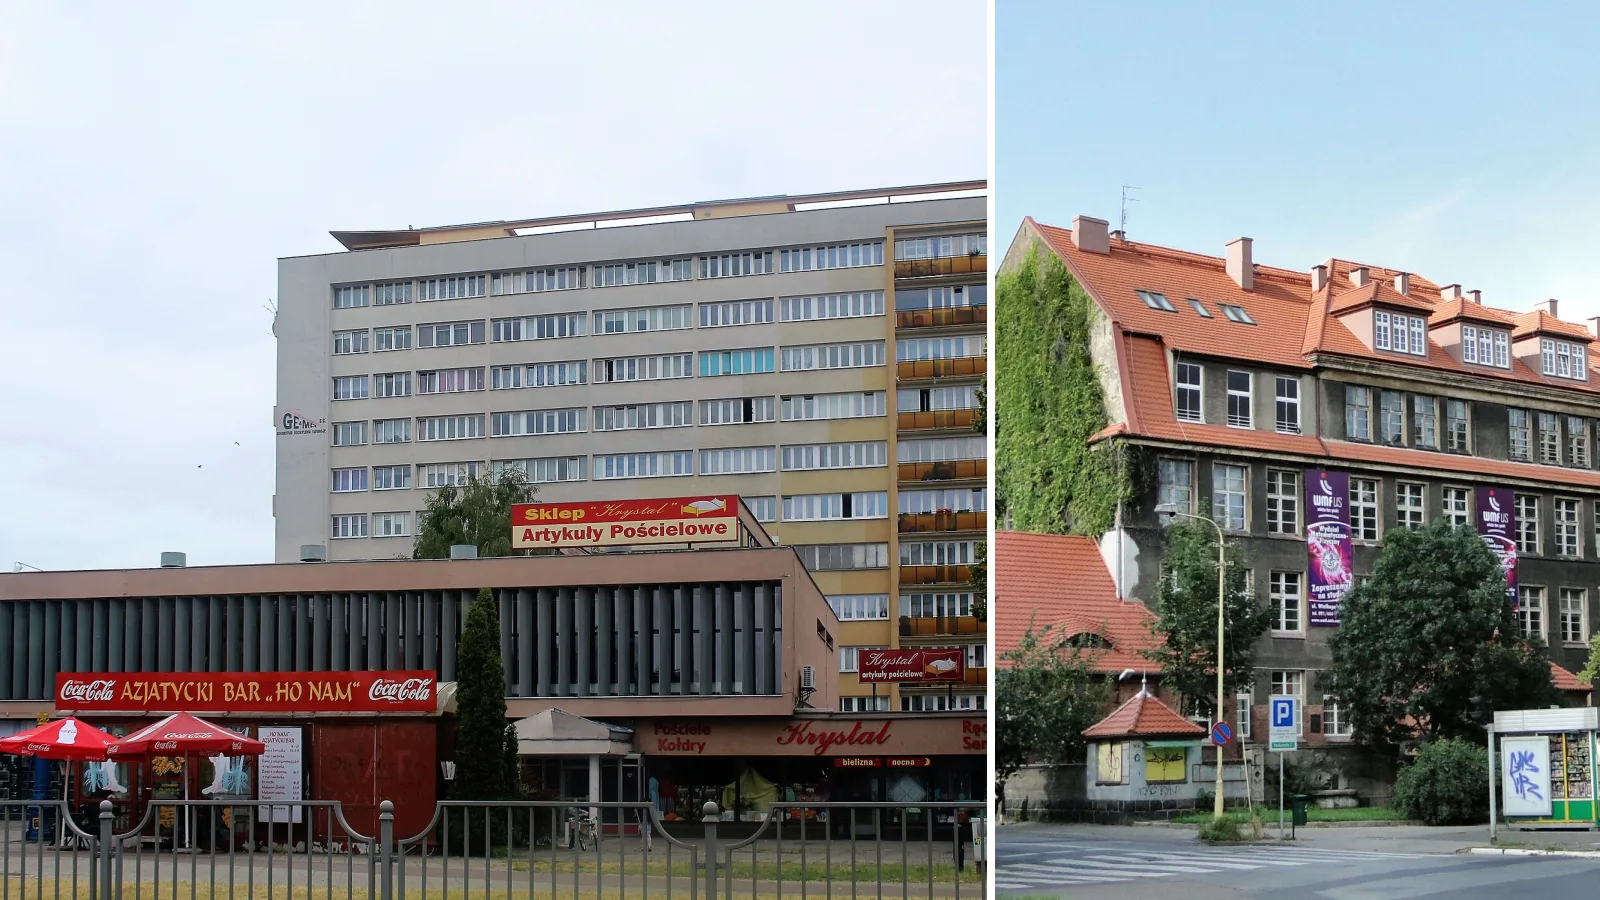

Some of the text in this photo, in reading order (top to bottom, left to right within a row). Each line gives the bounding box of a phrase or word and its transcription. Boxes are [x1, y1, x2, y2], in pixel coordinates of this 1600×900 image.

[524, 507, 586, 521] Sklep
[521, 521, 728, 544] Artykuły Pościelowe
[865, 652, 919, 669] Krystal
[861, 669, 924, 680] artykuły pościelowe
[60, 679, 117, 701] Coca-Cola
[120, 681, 213, 706] AZJATYCKI
[223, 681, 261, 702] BAR
[369, 678, 433, 701] Coca-Cola
[657, 737, 707, 754] Kołdry
[776, 720, 892, 756] Krystal
[842, 758, 915, 766] bielizna nocna
